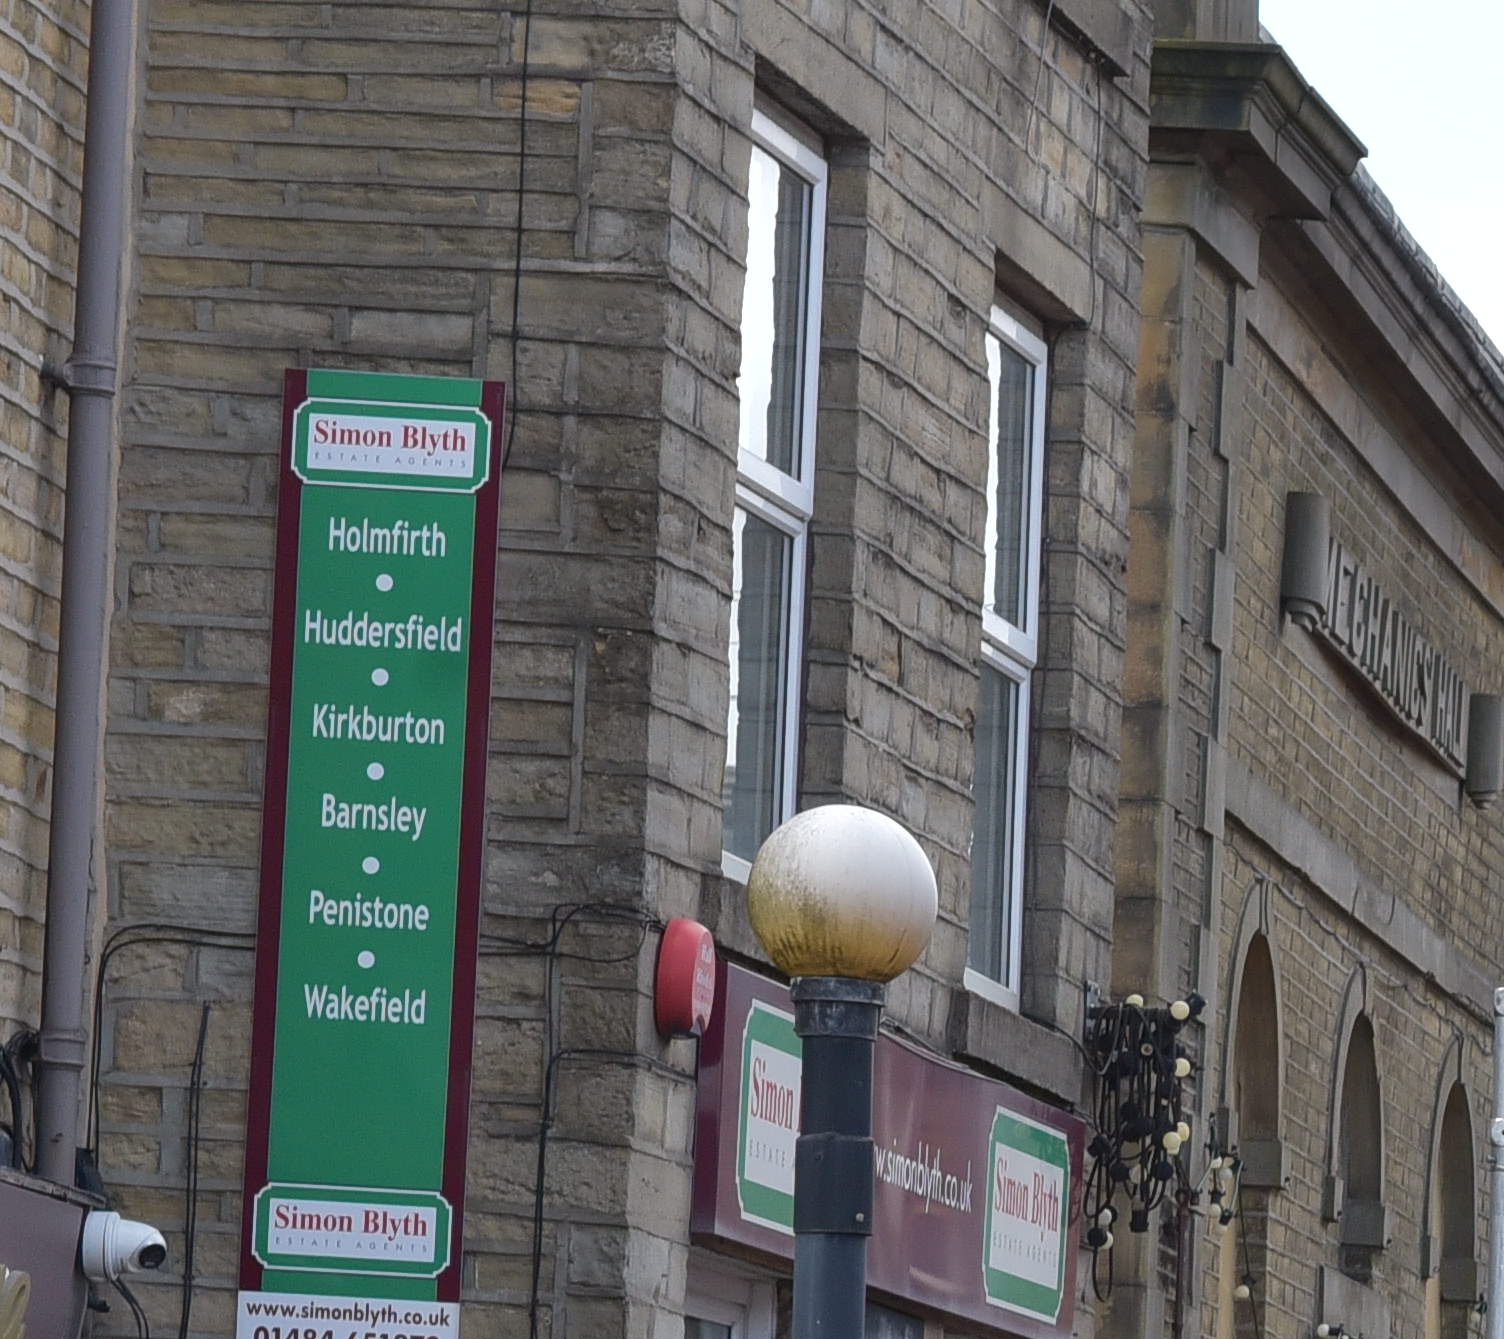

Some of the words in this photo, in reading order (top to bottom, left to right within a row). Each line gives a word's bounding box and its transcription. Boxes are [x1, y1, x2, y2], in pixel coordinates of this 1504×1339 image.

[313, 419, 392, 447] Simon
[401, 424, 467, 456] Blyth
[314, 452, 381, 463] ESTATE
[395, 457, 467, 468] AGENTS
[328, 516, 447, 557] Holmfirth
[304, 609, 463, 652] Huddersfield
[312, 703, 446, 745] Kirkburton
[321, 793, 427, 842] Barnsley
[308, 889, 430, 930] Penistone
[303, 983, 427, 1025] Wakefield
[751, 1056, 794, 1131] Simon
[993, 1156, 1030, 1221] Simon
[1030, 1168, 1060, 1242] Blyth
[273, 1204, 353, 1233] Simon
[362, 1209, 428, 1241] Blyth
[275, 1236, 342, 1249] ESTATE
[356, 1241, 428, 1253] AGENTS
[246, 1301, 451, 1328] www.simonblyth.co.uk
